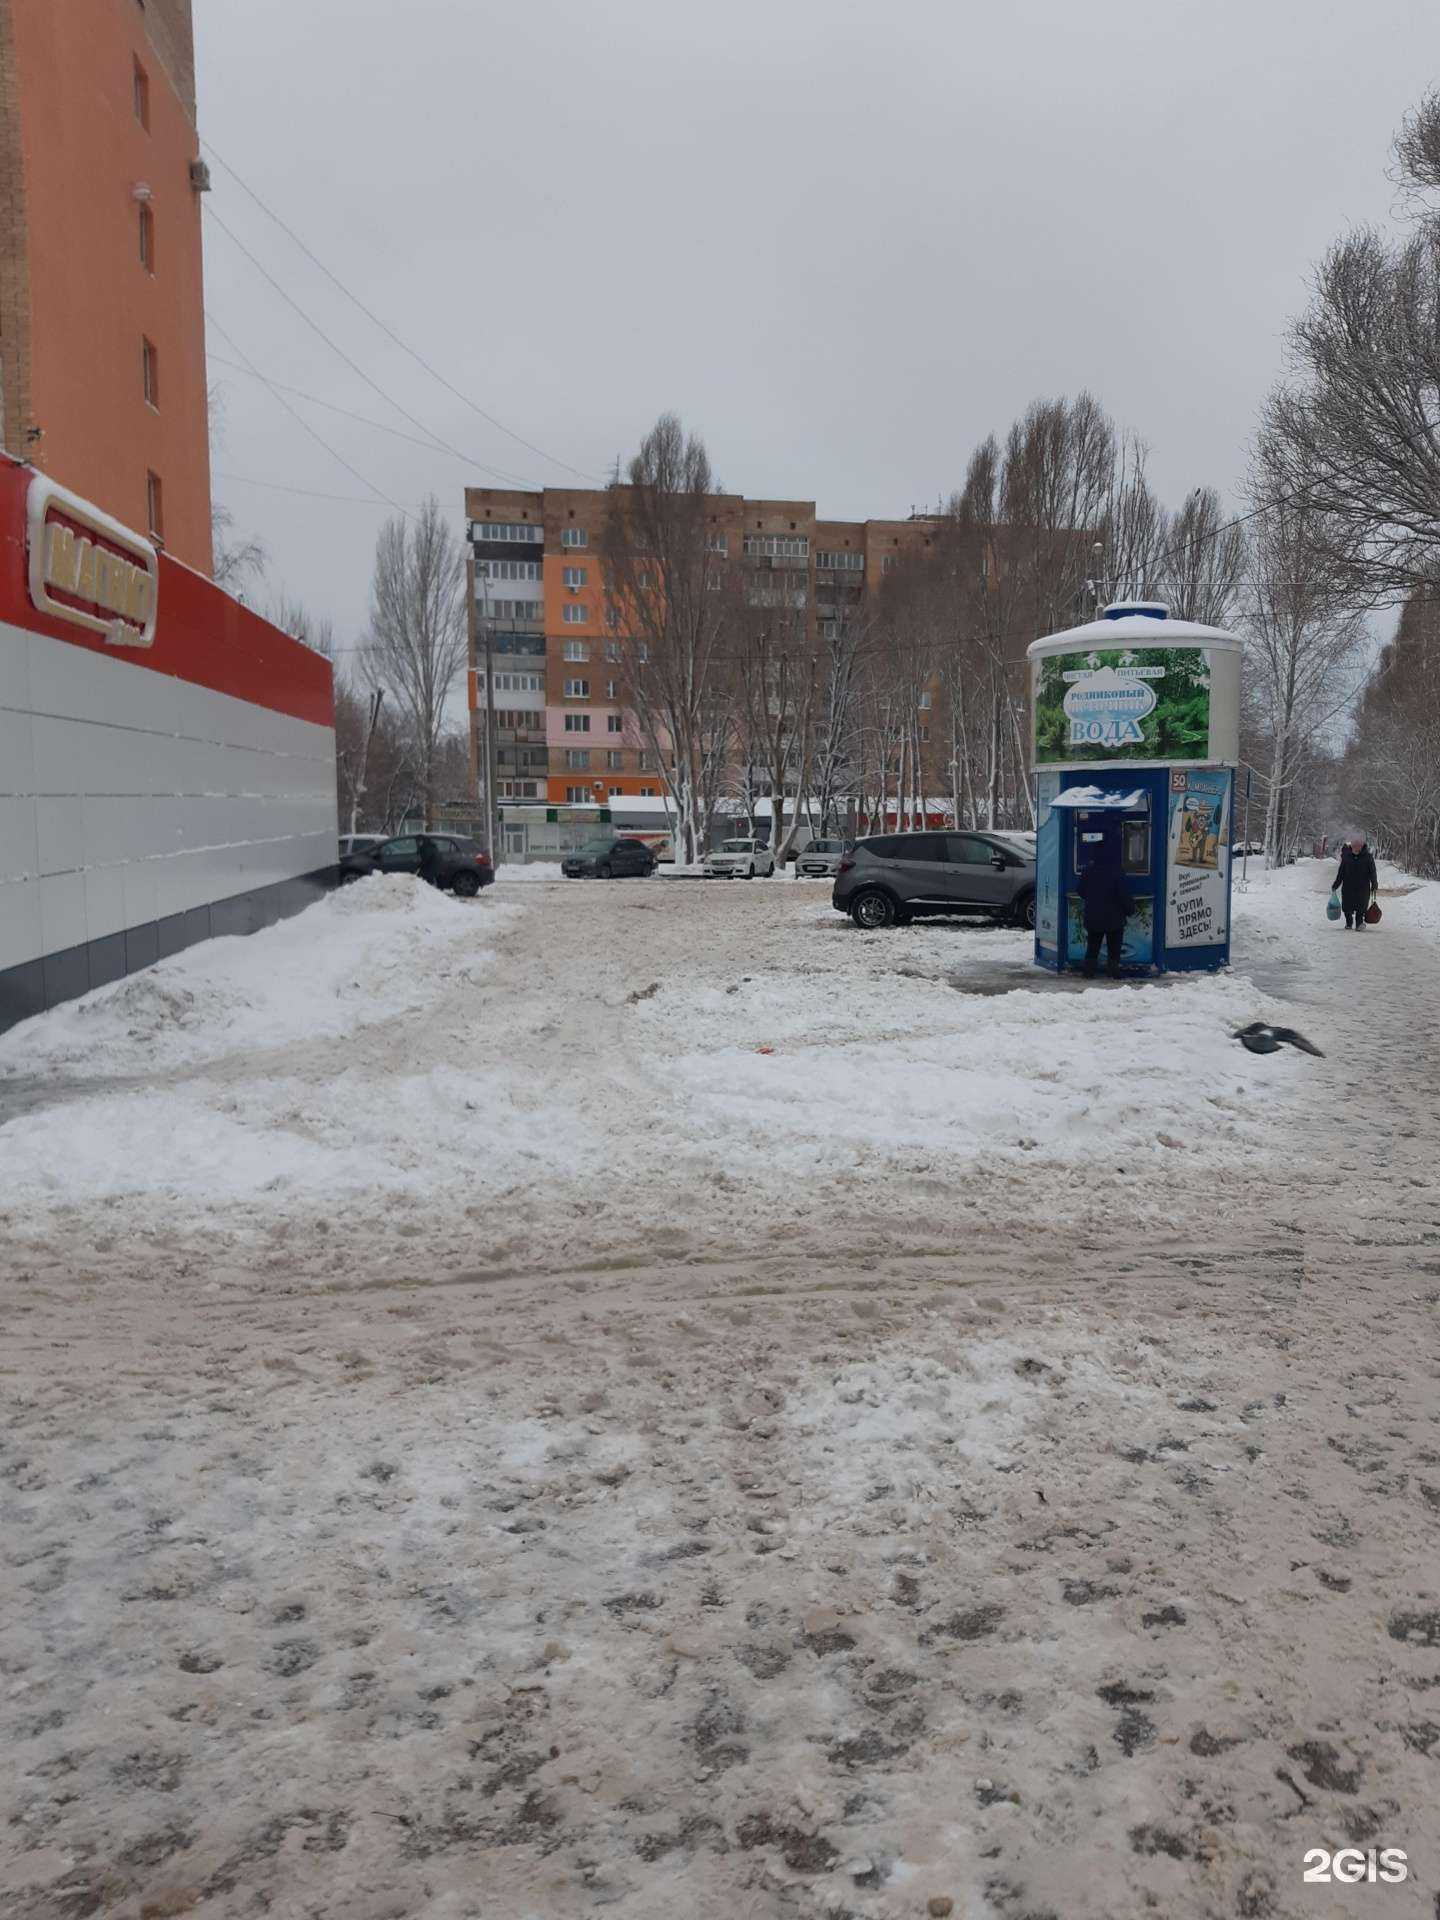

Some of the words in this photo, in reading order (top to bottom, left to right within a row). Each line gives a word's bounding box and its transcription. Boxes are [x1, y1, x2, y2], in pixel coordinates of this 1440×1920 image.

[1071, 688, 1145, 700] РОДНИКОВЫЙ
[1072, 720, 1141, 742] ВОДА
[1173, 774, 1186, 786] 50
[1176, 896, 1203, 914] КУПИ
[1178, 907, 1212, 927] ПРЯМО
[1179, 919, 1212, 940] ЗДЕСЬ!
